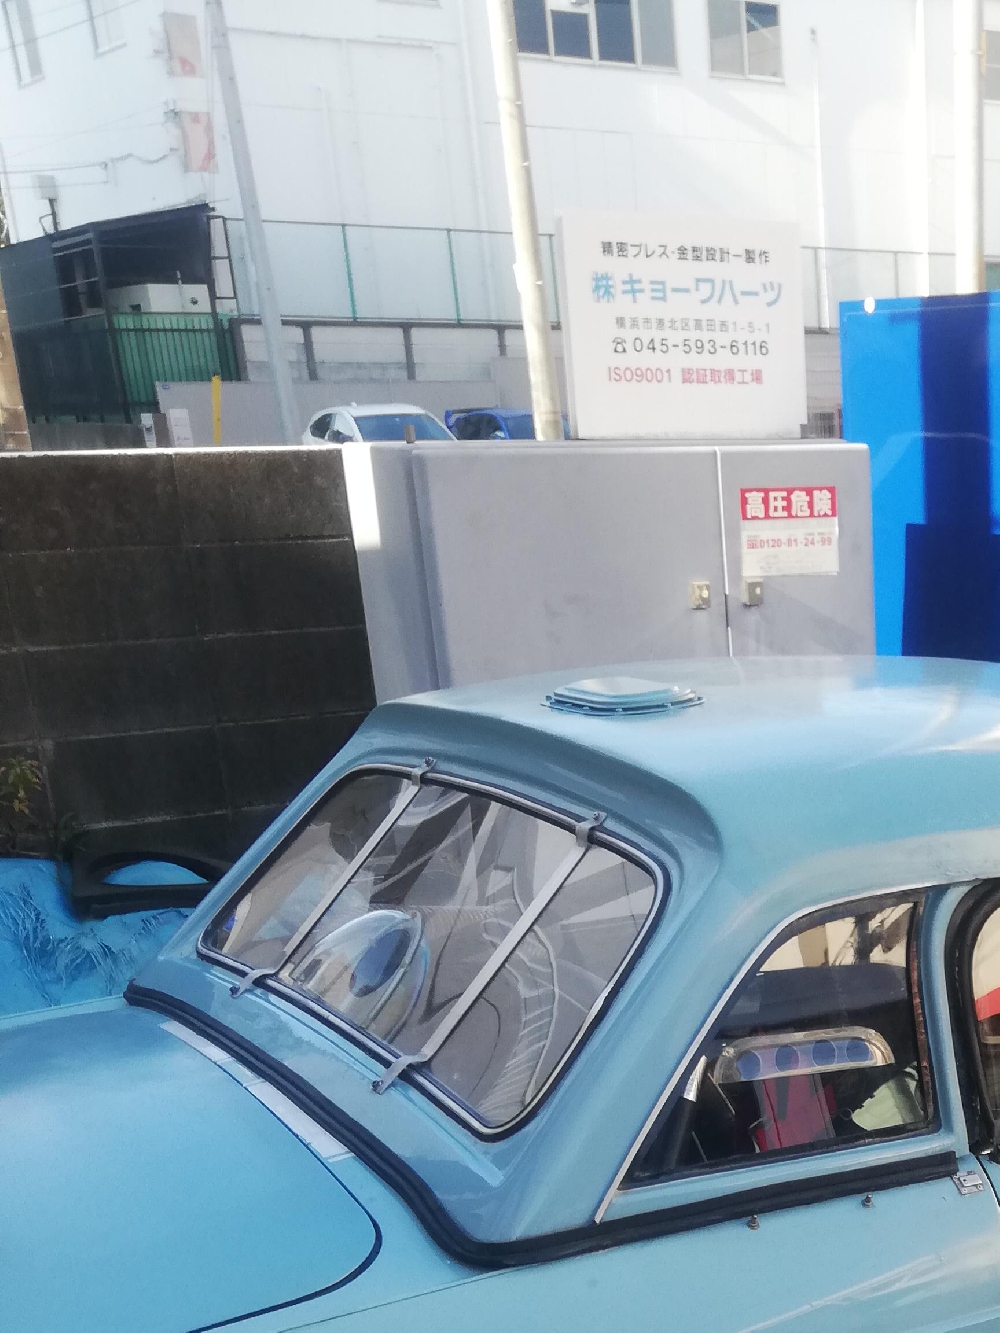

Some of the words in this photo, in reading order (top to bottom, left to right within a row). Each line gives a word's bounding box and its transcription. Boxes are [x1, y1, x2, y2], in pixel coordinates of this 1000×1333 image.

[633, 336, 769, 356] 045-593-6116
[608, 366, 672, 383] ISO9001
[681, 368, 763, 384] 認証取得工場
[745, 490, 832, 518] 高圧危険
